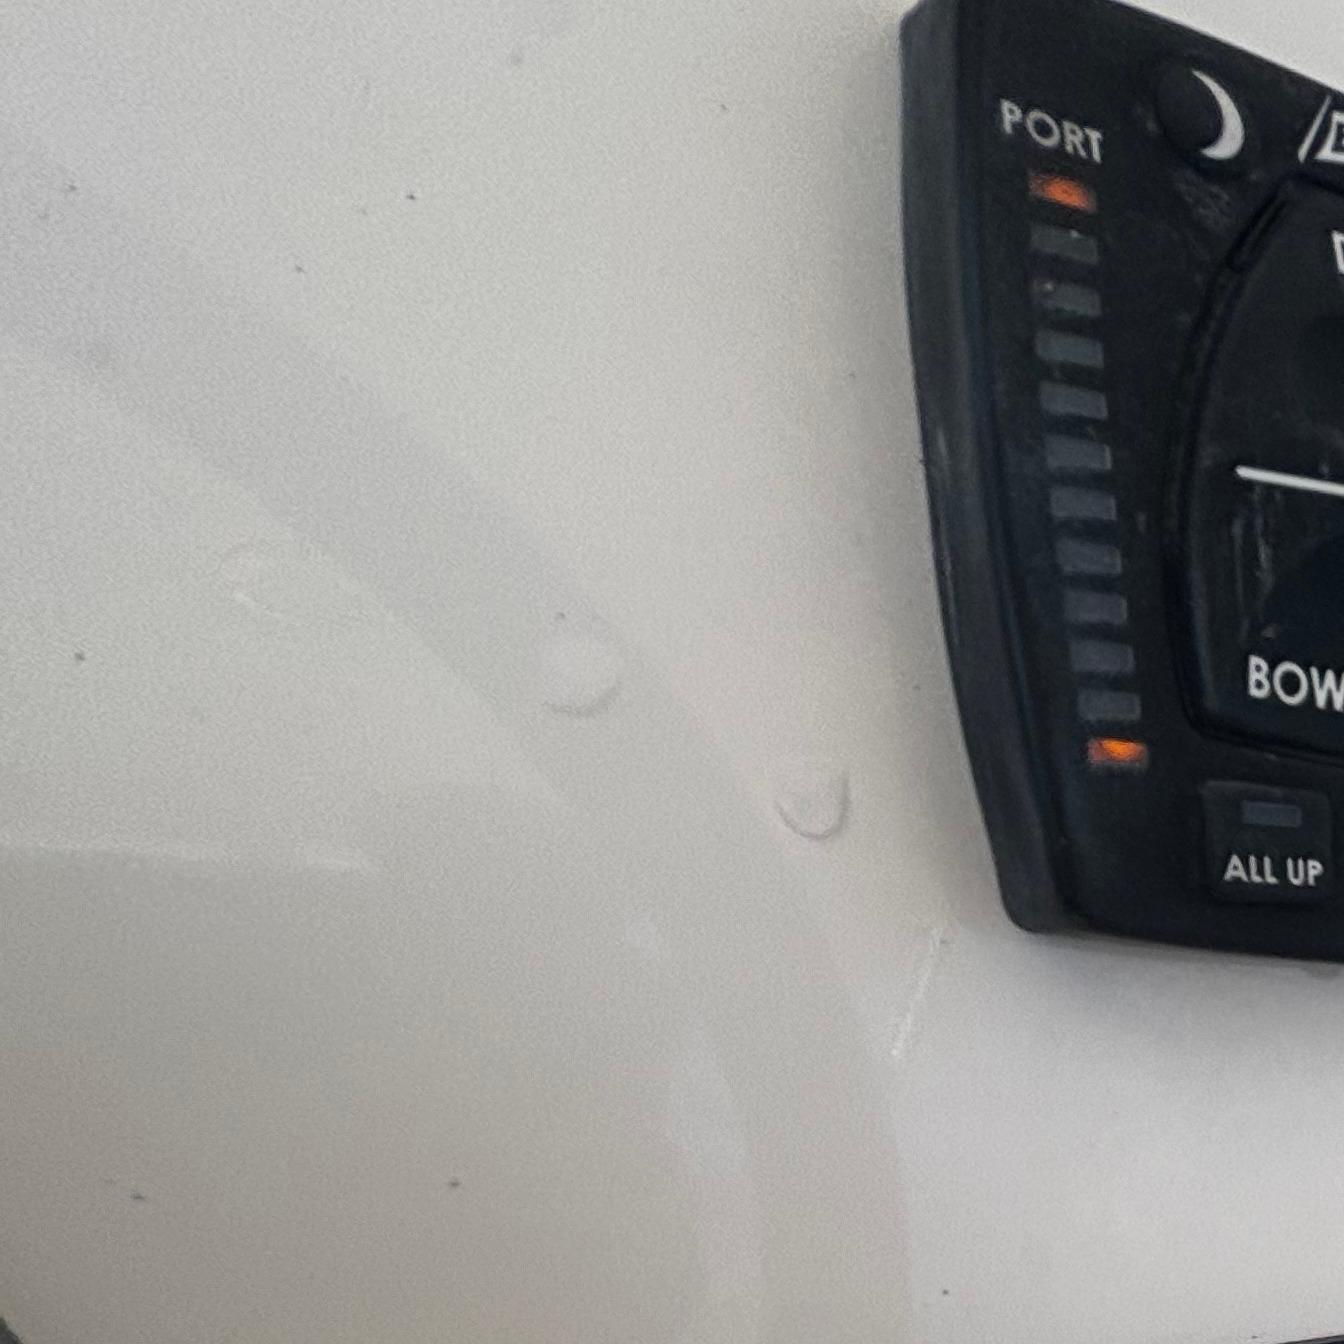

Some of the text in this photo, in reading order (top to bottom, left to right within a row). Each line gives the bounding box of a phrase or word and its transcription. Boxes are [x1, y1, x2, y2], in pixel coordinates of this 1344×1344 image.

[1001, 98, 1103, 165] PORT
[1224, 853, 1324, 888] ALL UP
